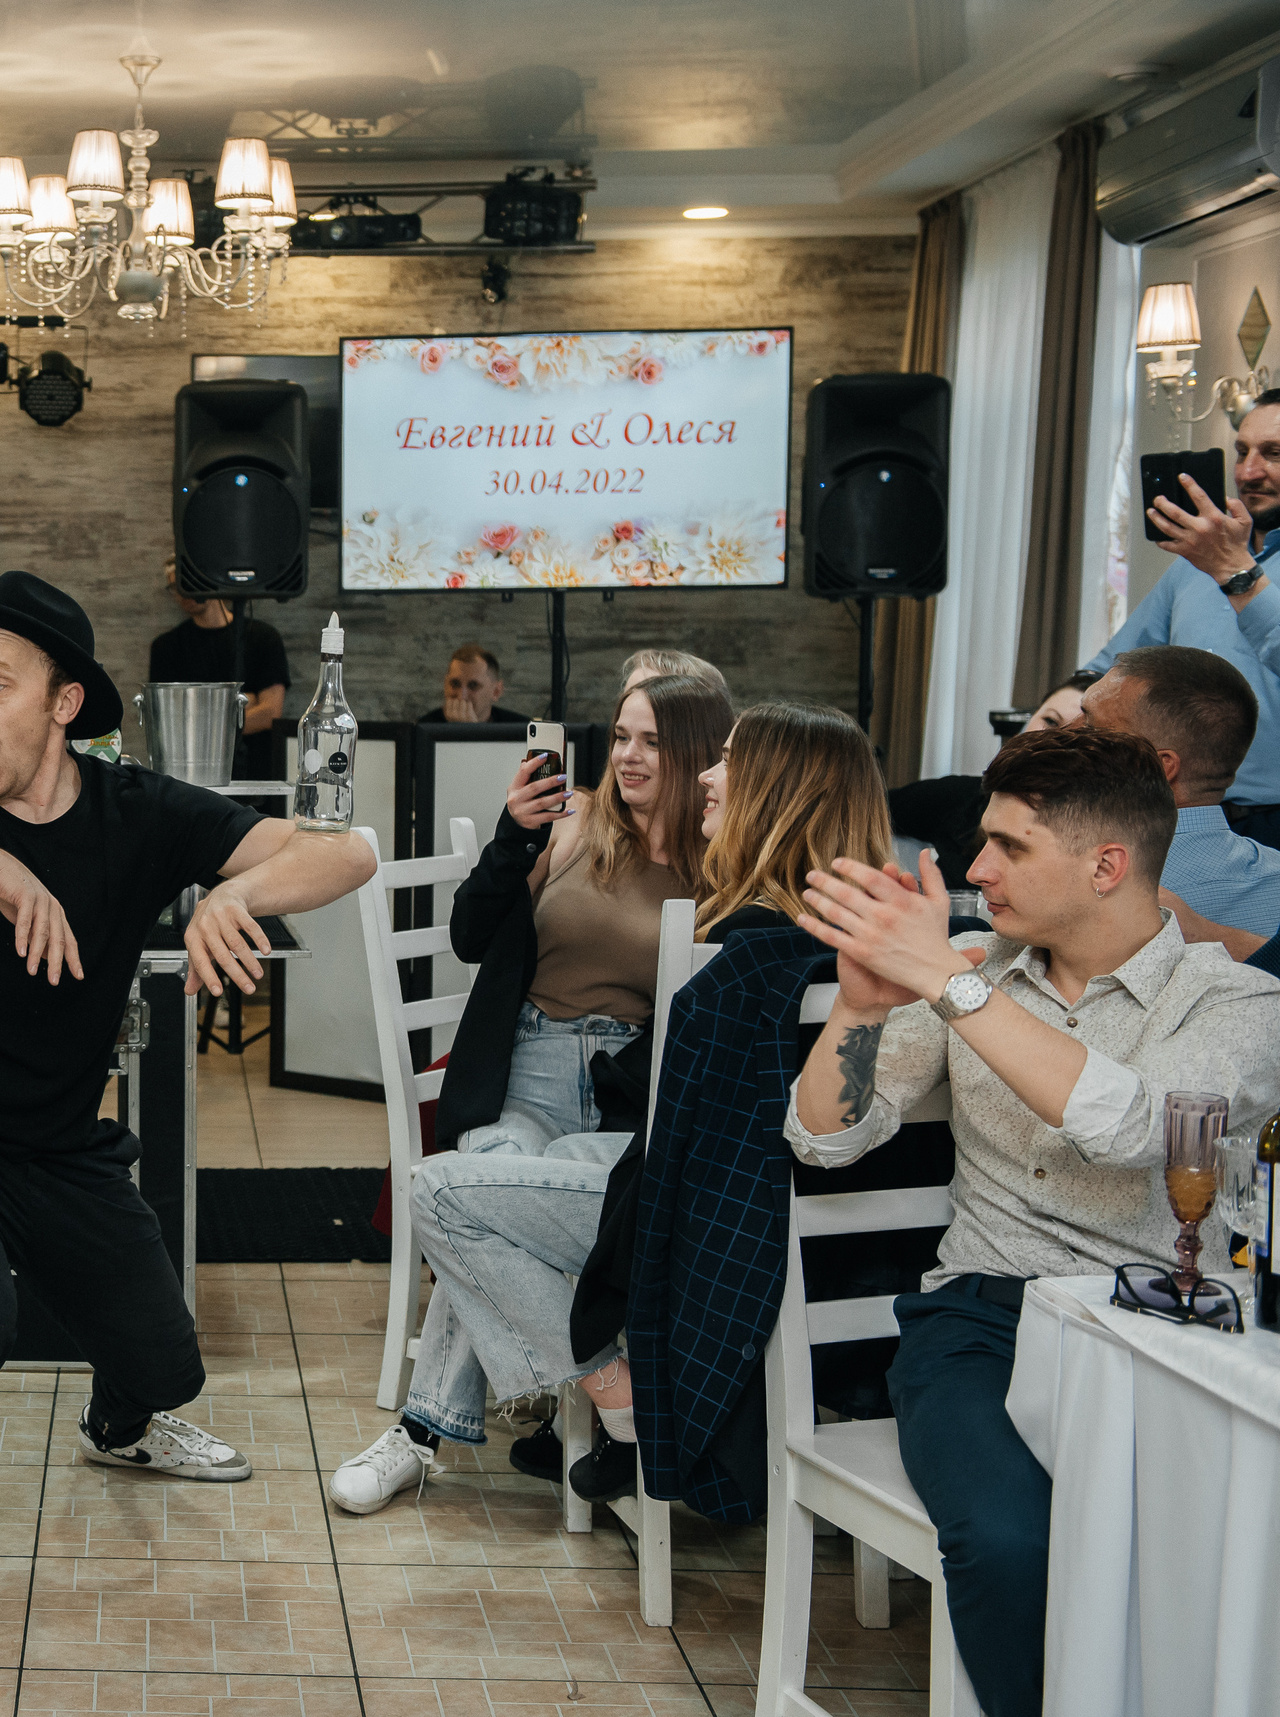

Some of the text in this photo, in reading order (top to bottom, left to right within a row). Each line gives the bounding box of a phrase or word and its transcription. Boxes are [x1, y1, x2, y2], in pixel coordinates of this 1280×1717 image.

[396, 408, 738, 450] Евгений & Олеся
[485, 468, 645, 496] 30.04.2022
